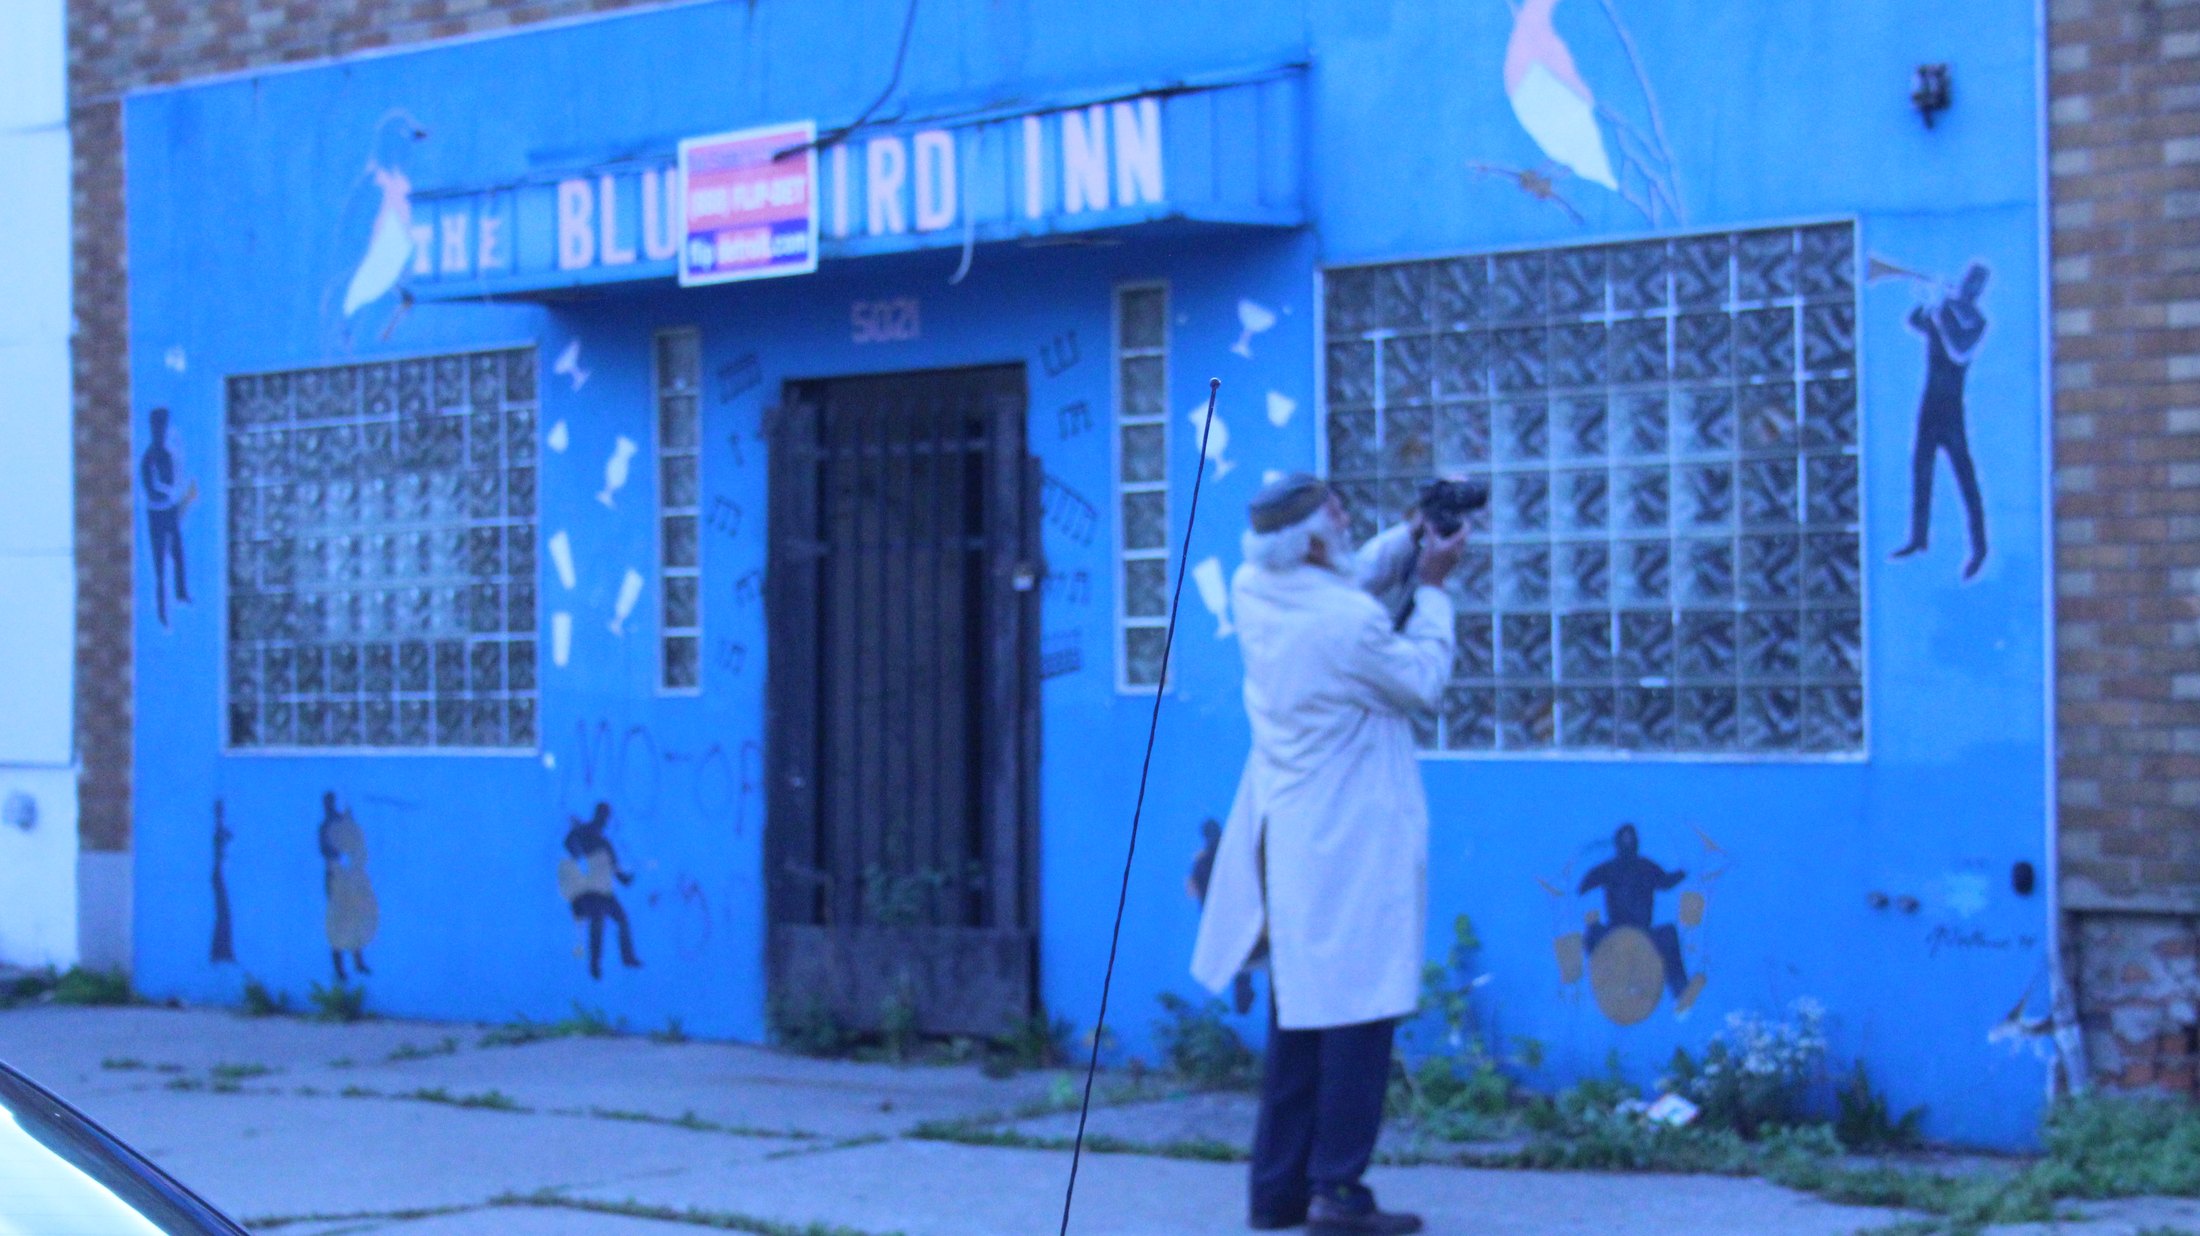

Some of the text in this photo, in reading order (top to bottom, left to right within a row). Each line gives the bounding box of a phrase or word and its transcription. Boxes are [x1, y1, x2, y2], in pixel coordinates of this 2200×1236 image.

[410, 97, 1165, 276] THE BLU IRD INN
[850, 297, 921, 344] 5021
